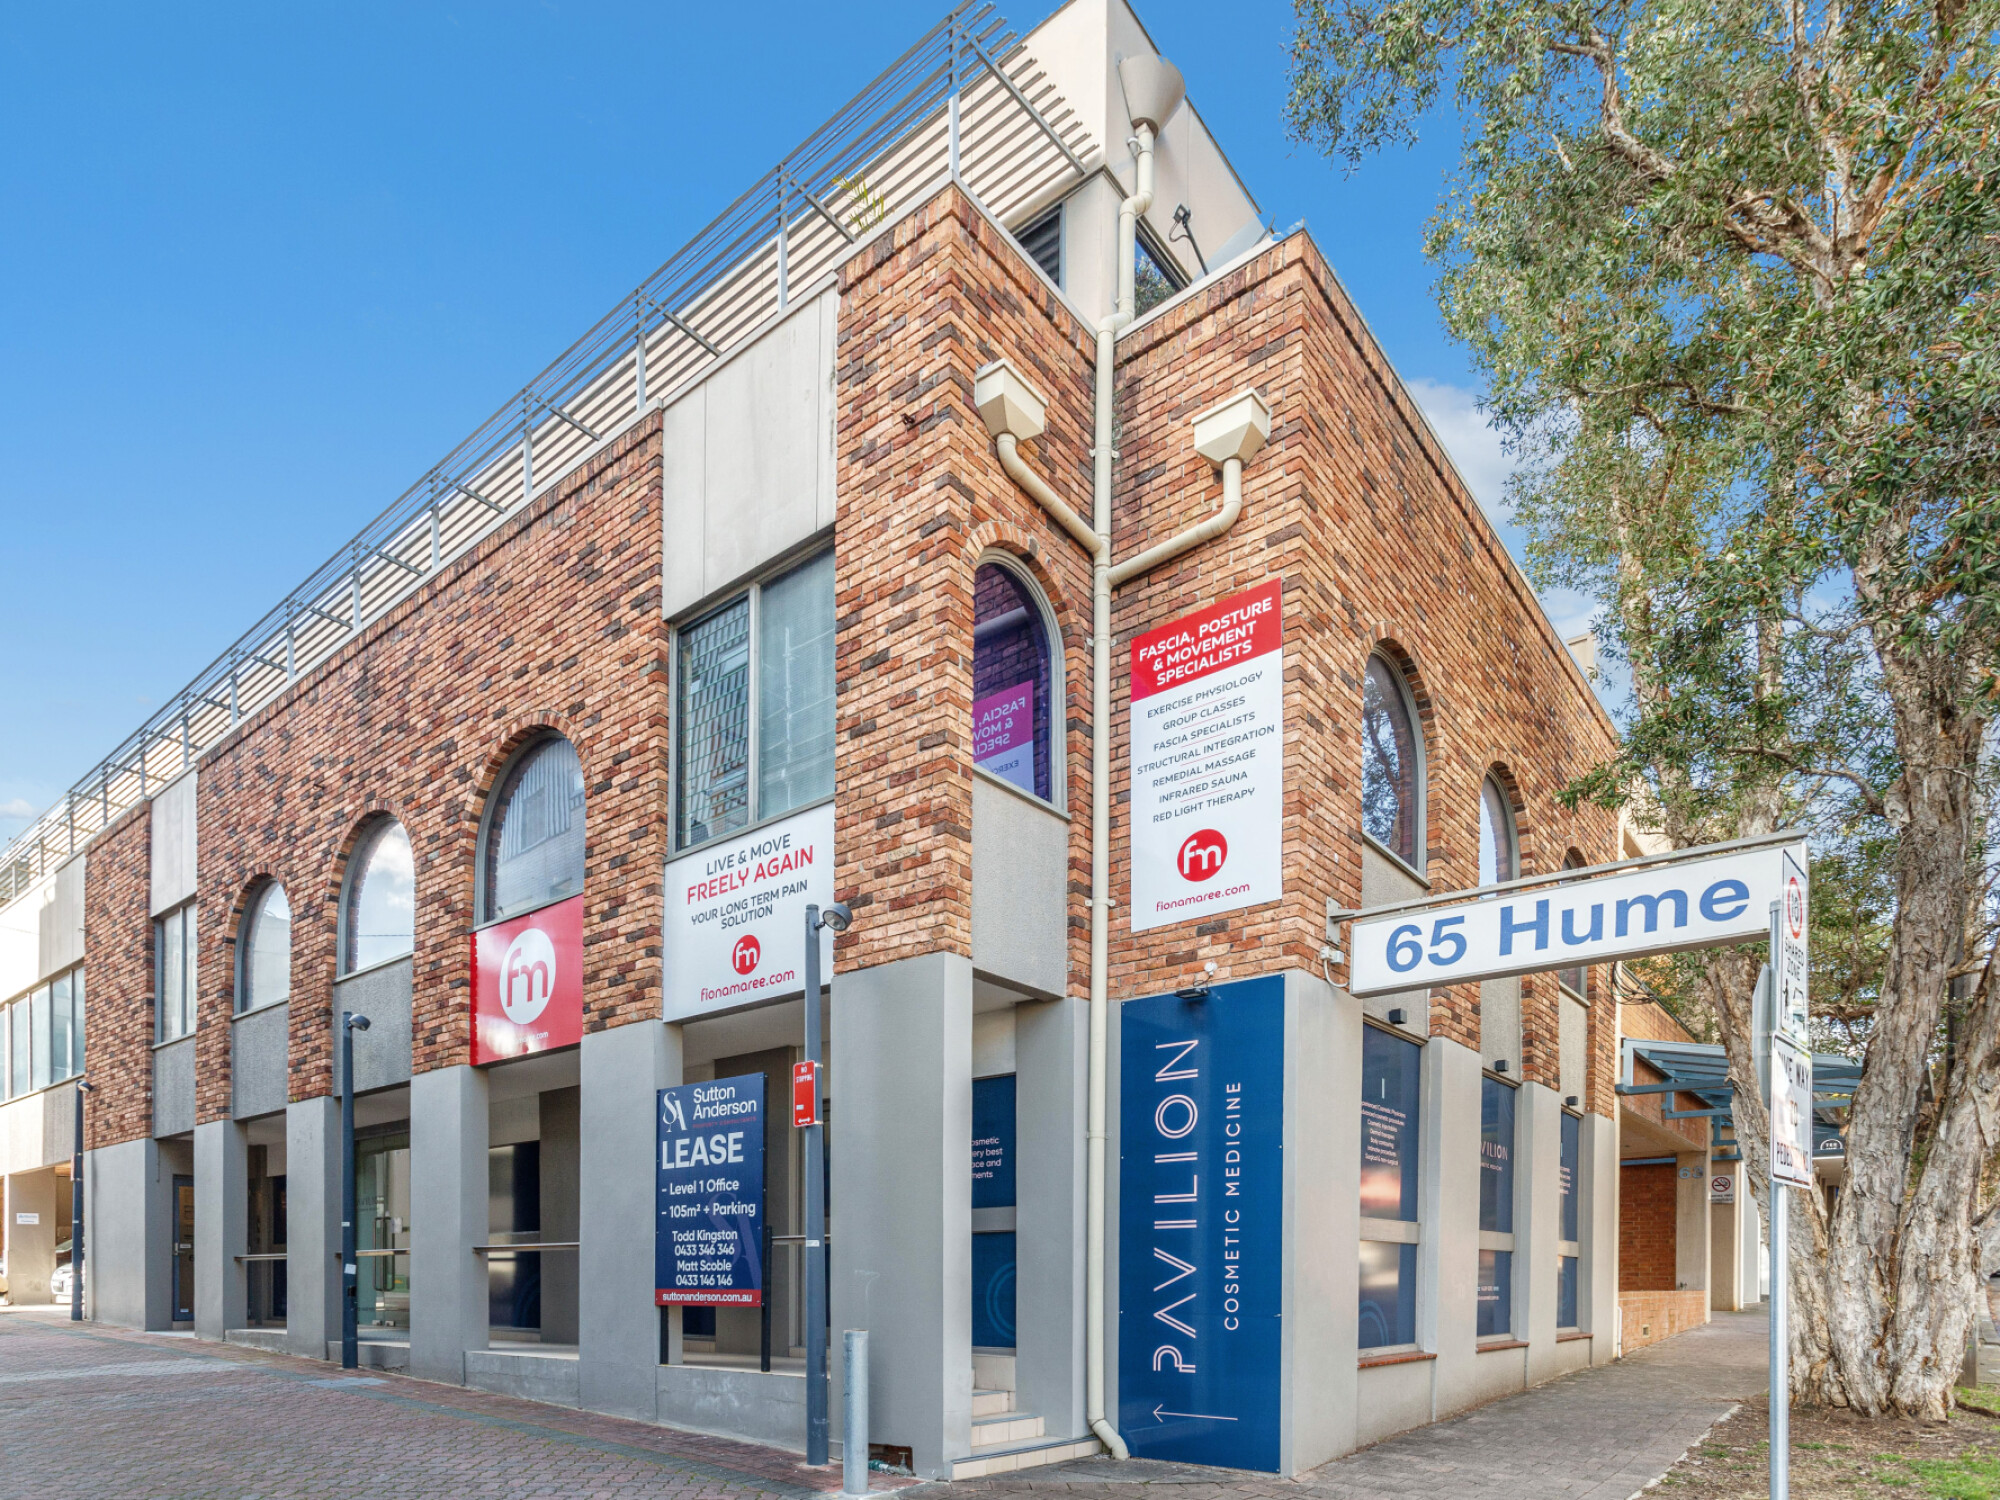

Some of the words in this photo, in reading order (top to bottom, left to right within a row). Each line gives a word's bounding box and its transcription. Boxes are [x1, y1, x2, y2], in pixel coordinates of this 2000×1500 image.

[1139, 632, 1195, 662] FASCIA,
[1199, 597, 1273, 638] POSTURE
[1153, 658, 1163, 671] &
[1167, 620, 1257, 667] MOVEMENT
[1157, 639, 1253, 686] SPECIALISTS
[1147, 695, 1193, 719] EXERCISE
[1195, 670, 1263, 702] PHYSIOLOGY
[1162, 712, 1198, 731] GROUP
[1200, 696, 1246, 718] CLASSES
[1153, 734, 1188, 752] FASCIA
[1190, 711, 1256, 740] SPECIALISTS
[1137, 748, 1201, 775] STRUCTURAL
[1203, 724, 1275, 754] INTEGRATION
[1152, 766, 1203, 788] REMEDIAL
[1205, 748, 1256, 772] MASSAGE
[1159, 782, 1209, 804] INFRARED
[1211, 771, 1248, 788] SAUNA
[1153, 811, 1172, 823] RED
[1174, 801, 1204, 817] LIGHT
[1206, 787, 1255, 808] THERAPY
[706, 854, 735, 876] LIVE
[738, 850, 747, 864] &
[750, 833, 791, 860] MOVE
[1184, 839, 1222, 875] fm
[687, 867, 749, 905] FREELY
[754, 845, 813, 883] AGAIN
[691, 908, 718, 925] YOUR
[720, 899, 748, 917] LONG
[750, 888, 780, 907] TERM
[781, 879, 808, 897] PAIN
[1156, 883, 1250, 912] fionamaree.com
[721, 904, 773, 930] SOLUTION
[1386, 915, 1467, 973] 65
[1499, 879, 1751, 957] Hume
[735, 942, 758, 969] fm
[1787, 957, 1800, 981] ZONE
[506, 947, 549, 1008] fm
[700, 969, 795, 1002] fionamaree.com
[1796, 1062, 1810, 1092] WAY
[693, 1086, 736, 1104] Sutton
[693, 1099, 757, 1120] Anderson
[662, 1131, 744, 1170] LEASE
[985, 1148, 1003, 1156] best
[1225, 1082, 1241, 1196] MEDICINE
[986, 1158, 1002, 1167] and
[1679, 1166, 1704, 1179] 63
[669, 1180, 697, 1195] Level
[699, 1180, 704, 1193] 1
[706, 1178, 739, 1193] Office
[703, 1205, 710, 1214] +
[713, 1201, 756, 1217] Parking
[1153, 1040, 1199, 1373] PAVILION
[672, 1230, 695, 1242] Todd
[697, 1229, 738, 1243] Kingston
[674, 1244, 697, 1256] 0433
[698, 1244, 715, 1256] 346
[717, 1243, 735, 1255] 346
[675, 1274, 698, 1286] 0433
[700, 1274, 715, 1286] 146
[717, 1274, 733, 1286] 146
[677, 1260, 698, 1272] Matt
[700, 1259, 732, 1271] Scoble
[1224, 1209, 1240, 1331] COSMETIC
[662, 1292, 753, 1302] suttonanderson.com.au
